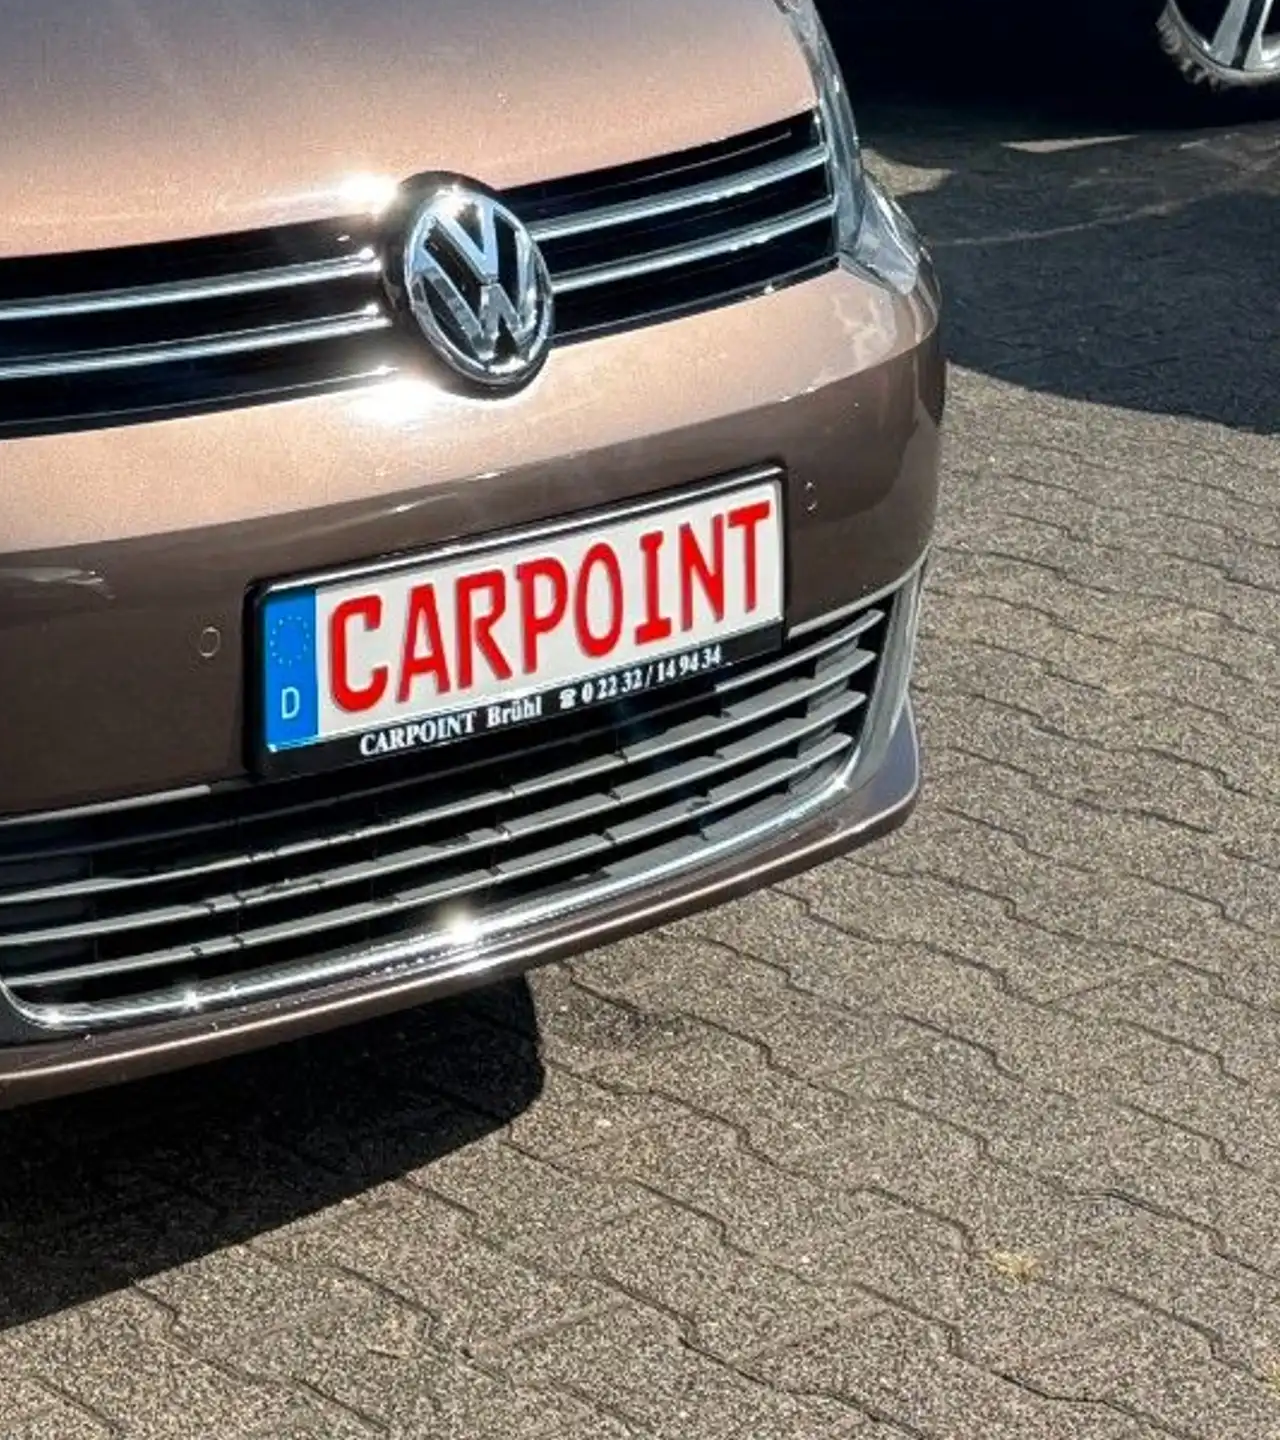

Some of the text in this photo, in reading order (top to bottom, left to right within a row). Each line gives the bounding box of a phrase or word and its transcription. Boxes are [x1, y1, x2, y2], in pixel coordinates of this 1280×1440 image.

[328, 499, 771, 713] CARPOINT
[280, 687, 300, 720] D
[359, 710, 478, 757] CARPOINT
[486, 696, 543, 728] Brühl
